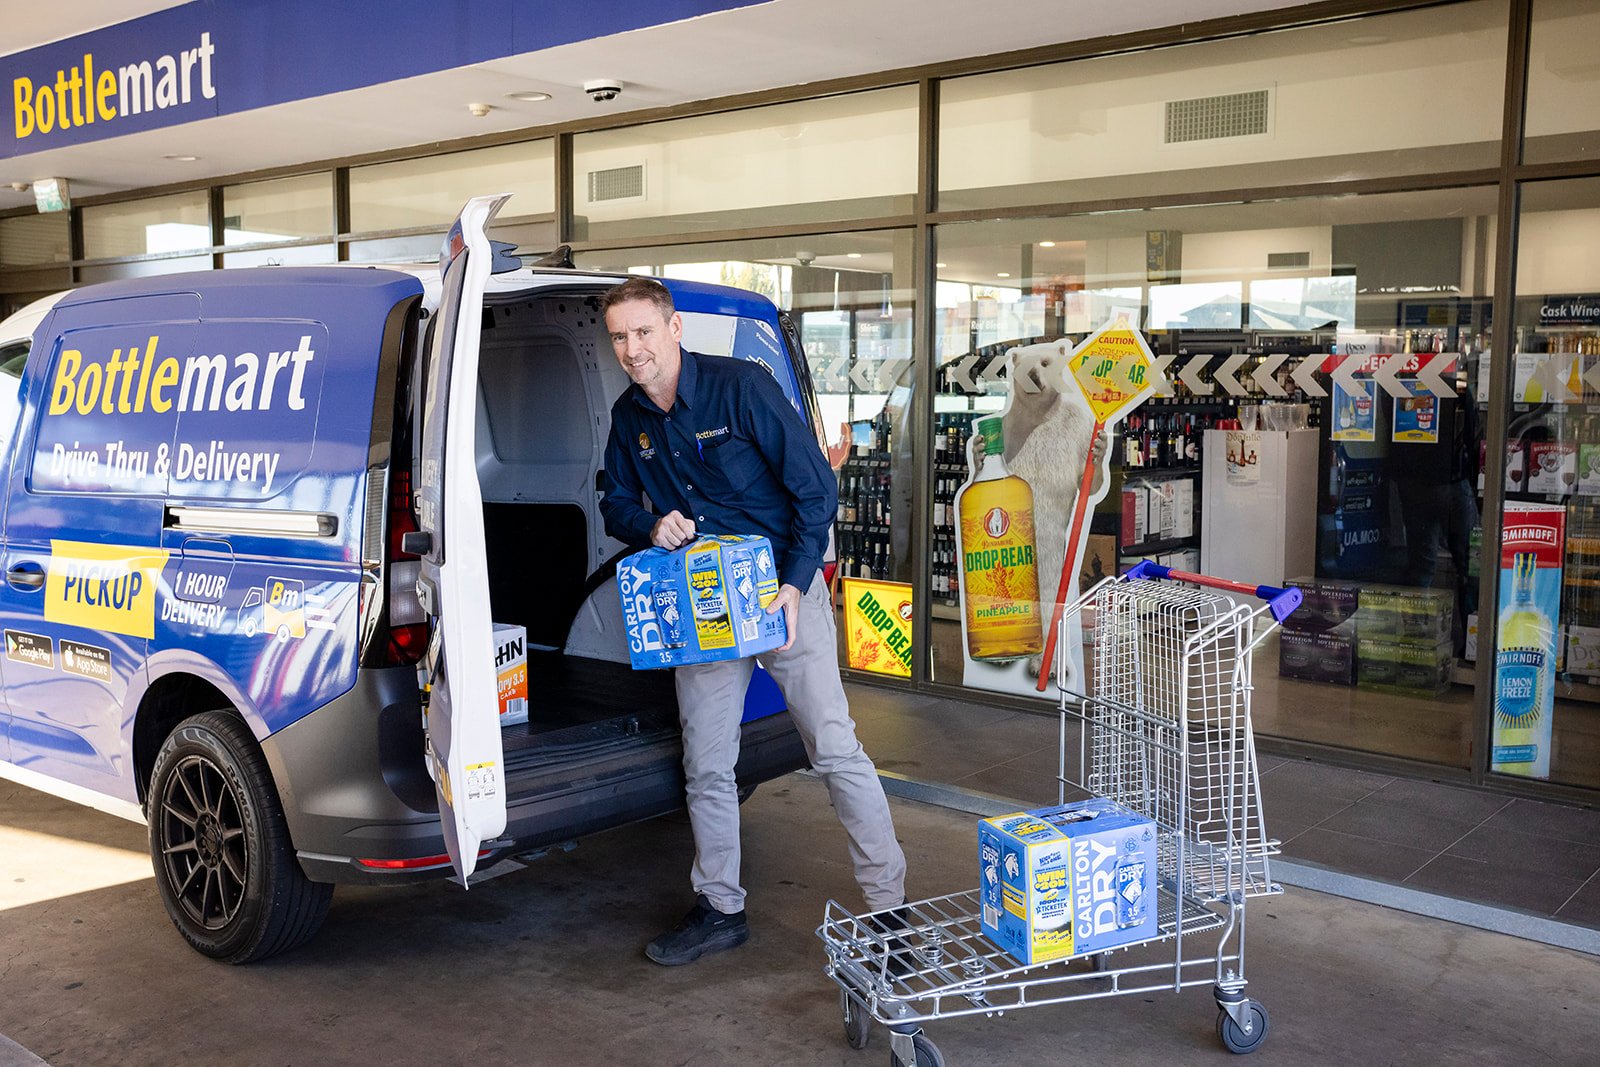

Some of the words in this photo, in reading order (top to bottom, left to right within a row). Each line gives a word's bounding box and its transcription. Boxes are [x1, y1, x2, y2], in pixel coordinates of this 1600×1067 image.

[14, 32, 216, 139] Bottlemart
[1540, 304, 1567, 317] Cask
[1098, 336, 1135, 345] CAUTION
[49, 335, 315, 416] Bottlemart
[695, 426, 730, 440] Bottlemart
[50, 442, 99, 478] Drive
[105, 441, 149, 480] Thru
[154, 444, 172, 481] &
[176, 442, 280, 494] Delivery
[1502, 528, 1553, 541] SMIRNOFF
[966, 549, 999, 573] DROP
[1000, 545, 1033, 568] BEAR
[691, 570, 718, 582] WIN
[734, 566, 752, 579] DRY
[63, 563, 143, 611] PICKUP
[175, 570, 184, 596] 1
[186, 572, 227, 598] HOUR
[268, 581, 300, 607] Bm
[657, 595, 677, 606] DRY
[162, 598, 228, 628] DELIVERY
[620, 566, 643, 654] CARLTON
[630, 566, 664, 652] DRY
[976, 604, 1030, 618] PINEAPPLE
[857, 591, 894, 633] DROP
[886, 627, 913, 671] BEA
[19, 644, 38, 661] Google
[38, 648, 51, 664] Play
[77, 657, 89, 674] App
[90, 659, 108, 676] Store
[1502, 676, 1533, 688] LEMON
[1502, 687, 1532, 699] FREEZE
[1035, 868, 1066, 883] WIN
[1119, 863, 1145, 874] CARLTON
[1119, 869, 1144, 882] DRY
[1075, 840, 1093, 939] CARLTON
[1091, 839, 1118, 936] DRY
[1041, 901, 1068, 912] TICKETEK
